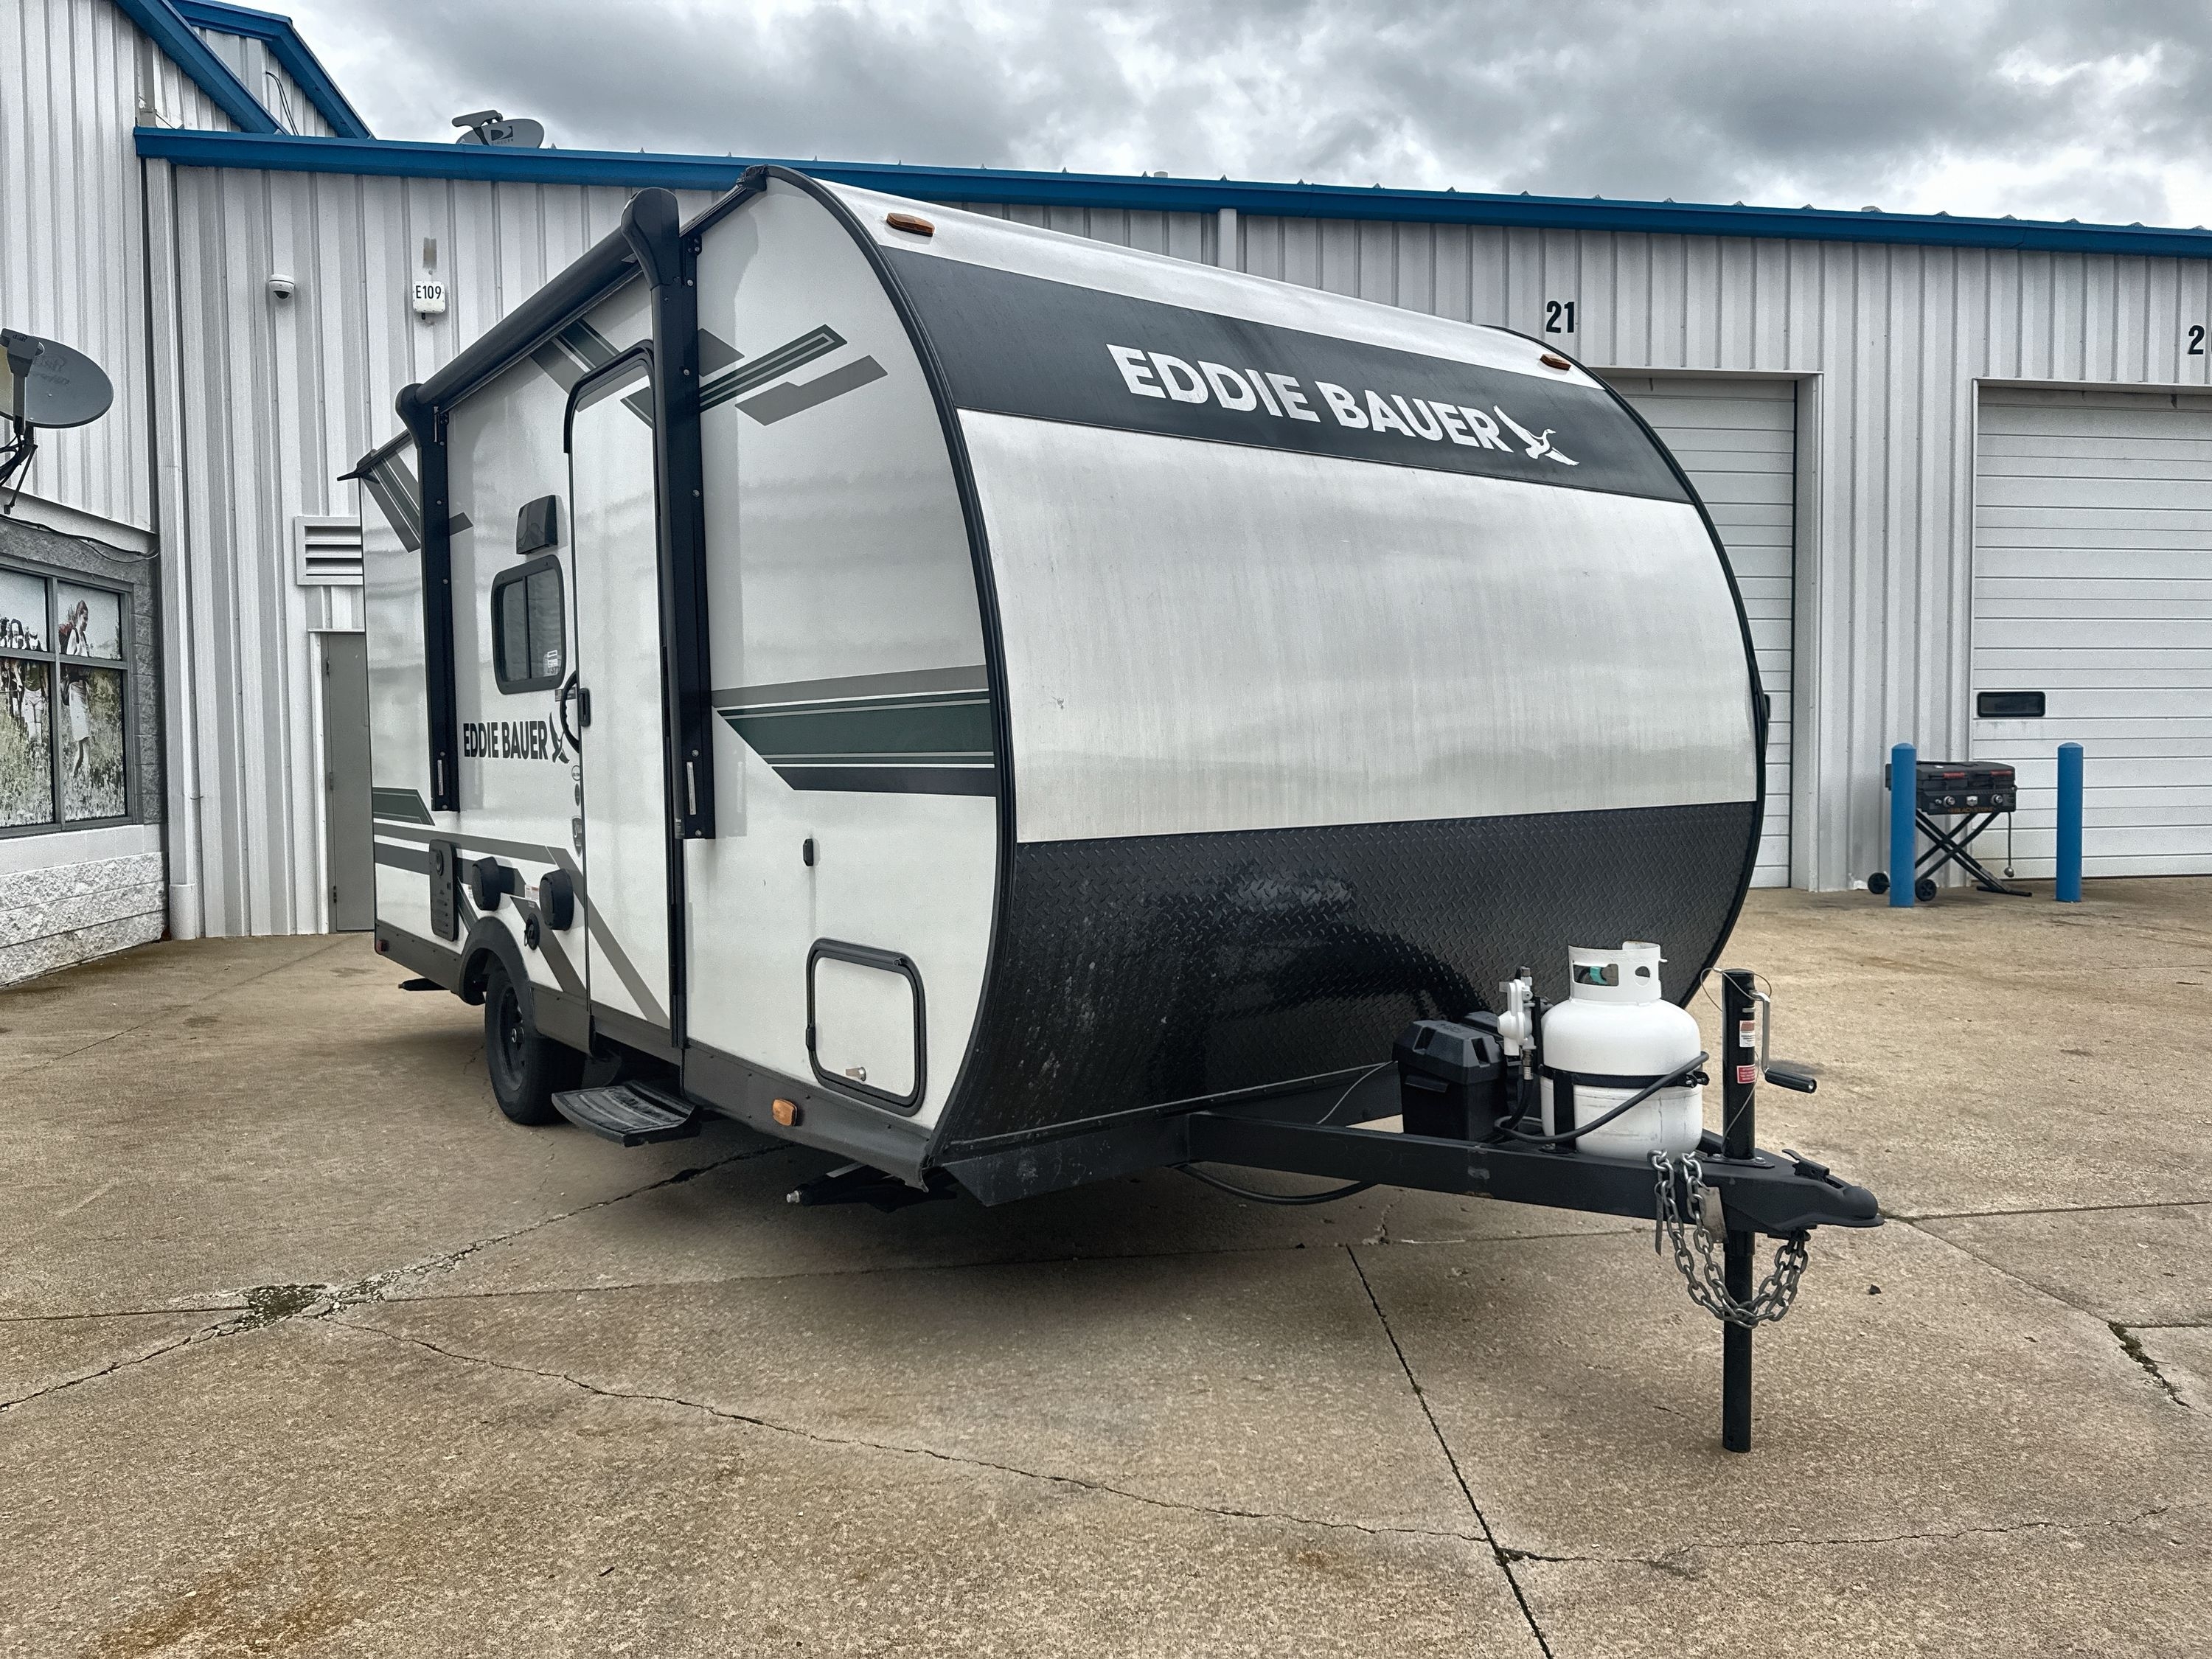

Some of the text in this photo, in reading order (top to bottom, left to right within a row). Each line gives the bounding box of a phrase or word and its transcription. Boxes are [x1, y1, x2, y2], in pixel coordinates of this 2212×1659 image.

[416, 285, 441, 299] E109
[1546, 301, 1574, 333] 21
[2188, 325, 2212, 355] 2
[1106, 344, 1514, 453] EDDIE BAUER
[463, 721, 548, 759] EDDIE BAUER
